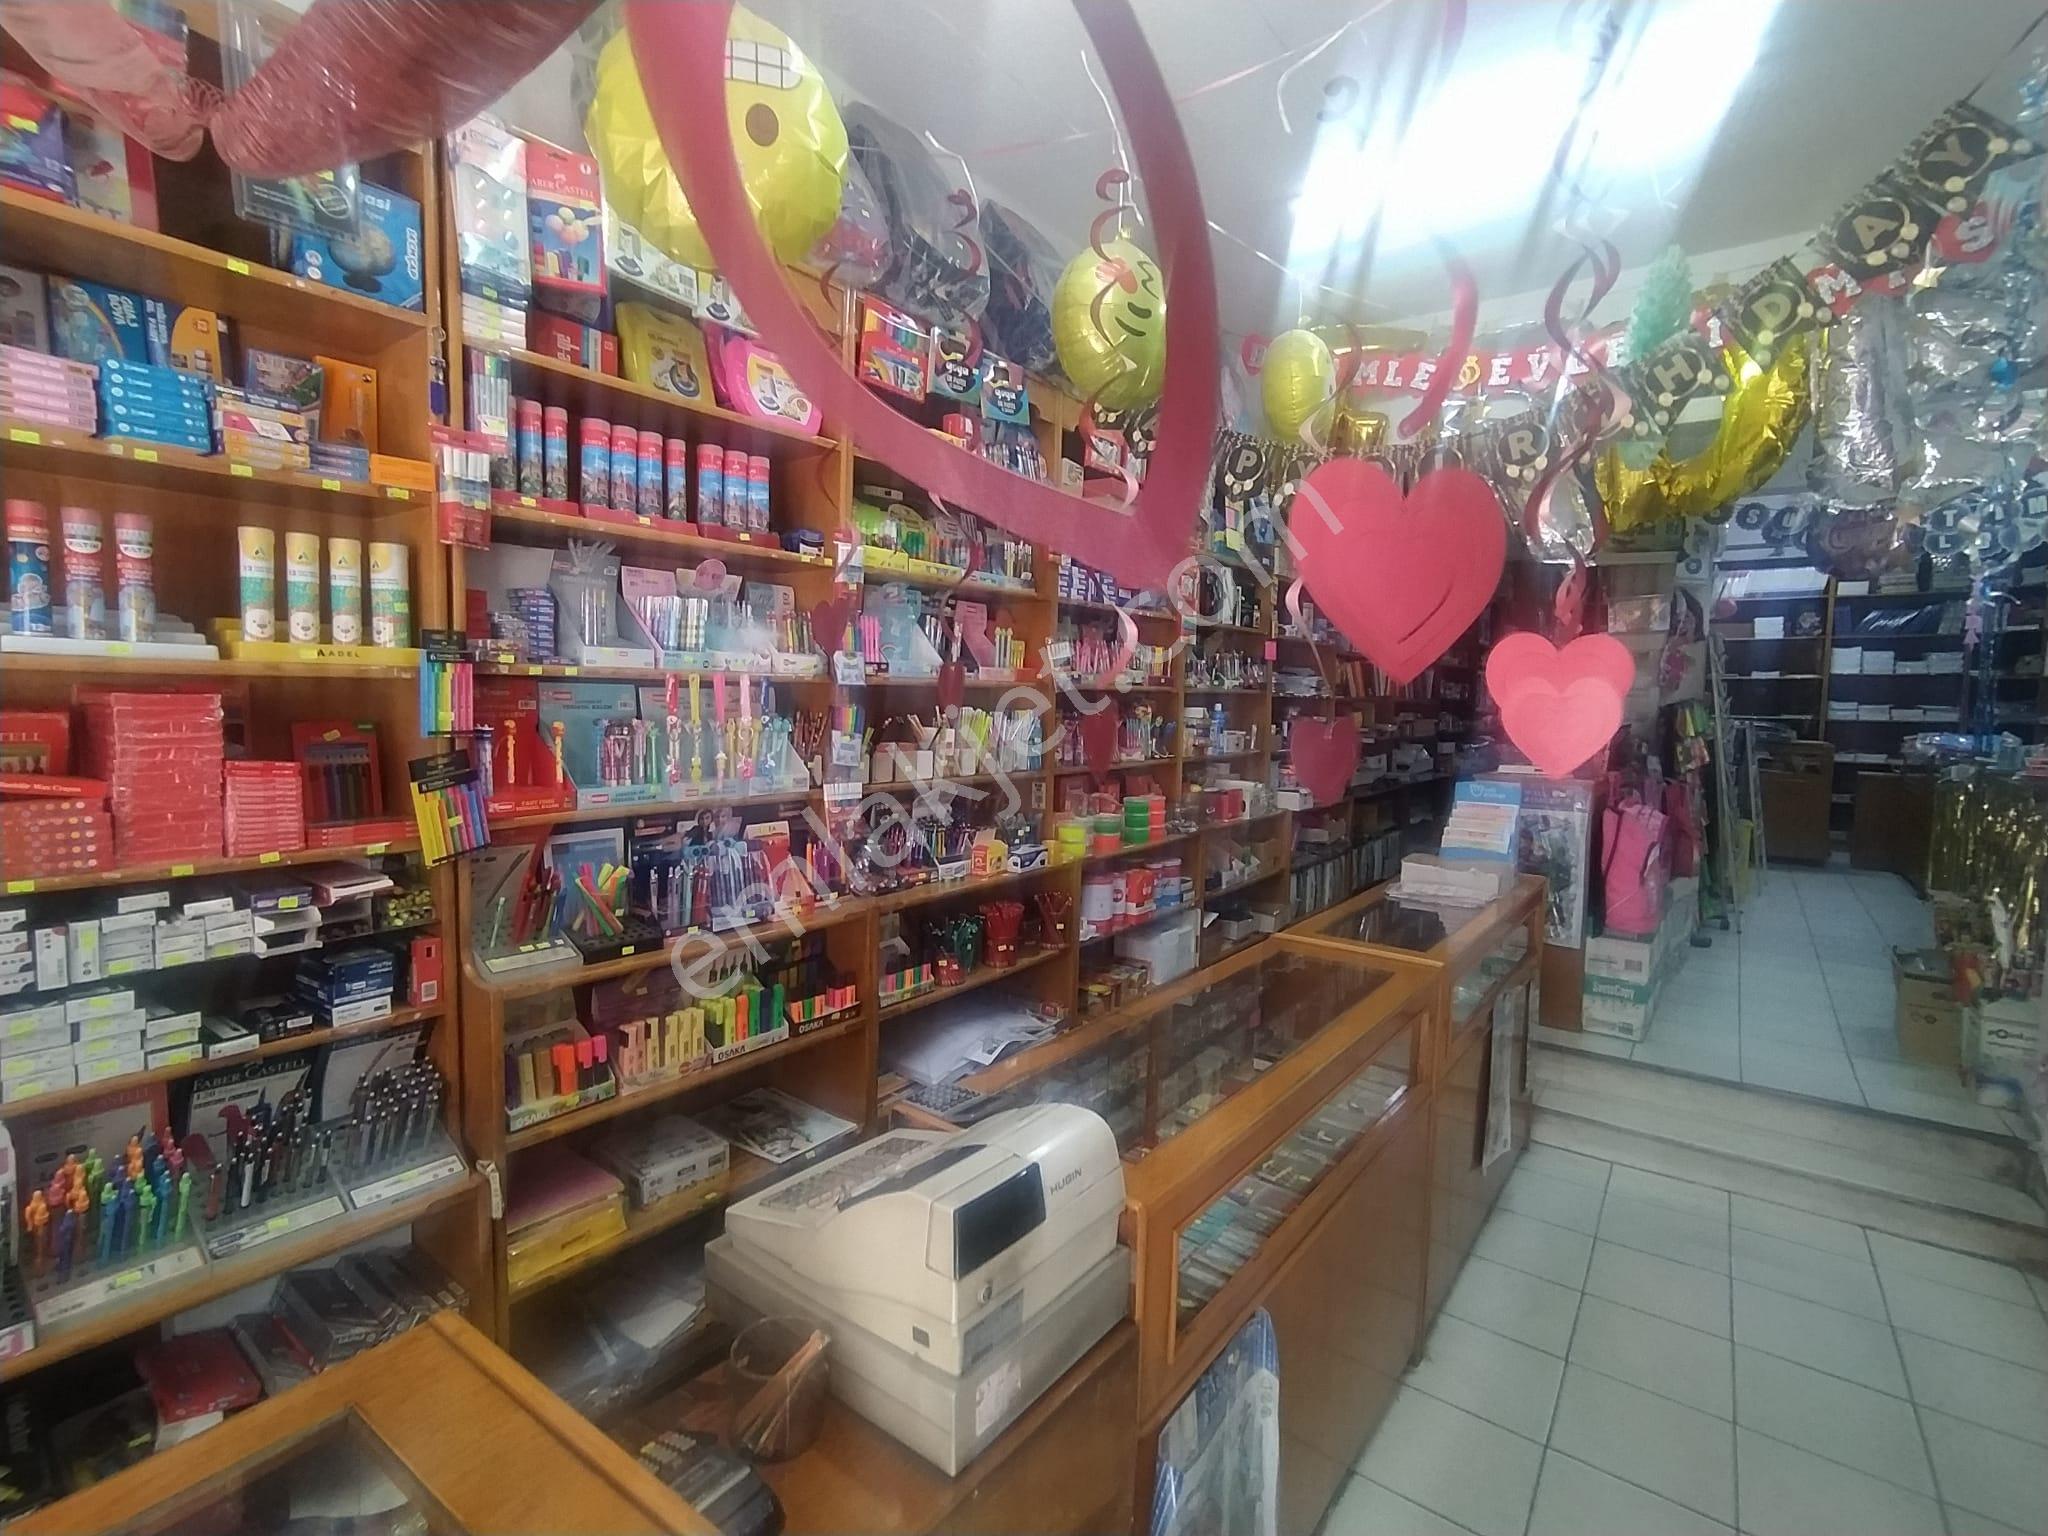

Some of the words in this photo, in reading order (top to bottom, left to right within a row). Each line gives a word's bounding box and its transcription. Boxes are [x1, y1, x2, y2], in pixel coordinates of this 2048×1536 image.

[799, 1020, 824, 1034] OSAKA
[717, 1045, 746, 1060] OSAKA
[245, 1058, 305, 1078] CASTELL
[1050, 1167, 1082, 1196] HUGIN
